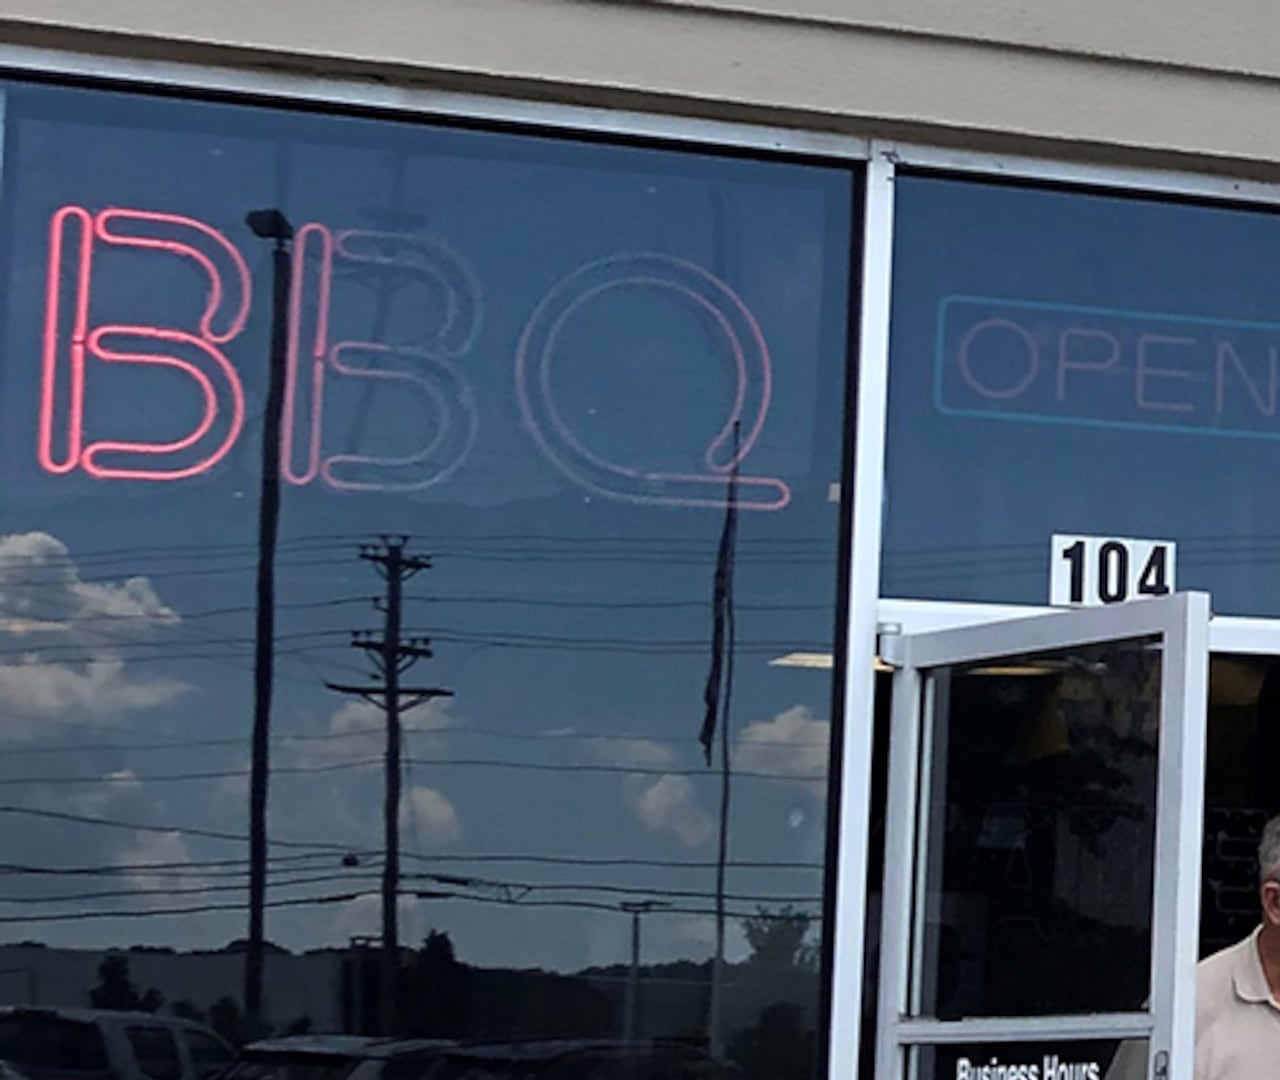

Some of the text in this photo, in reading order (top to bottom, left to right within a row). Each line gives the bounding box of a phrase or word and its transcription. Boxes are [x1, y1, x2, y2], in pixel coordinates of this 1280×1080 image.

[38, 205, 792, 511] BBQ
[957, 317, 1278, 417] OPEN
[1062, 541, 1170, 604] 104
